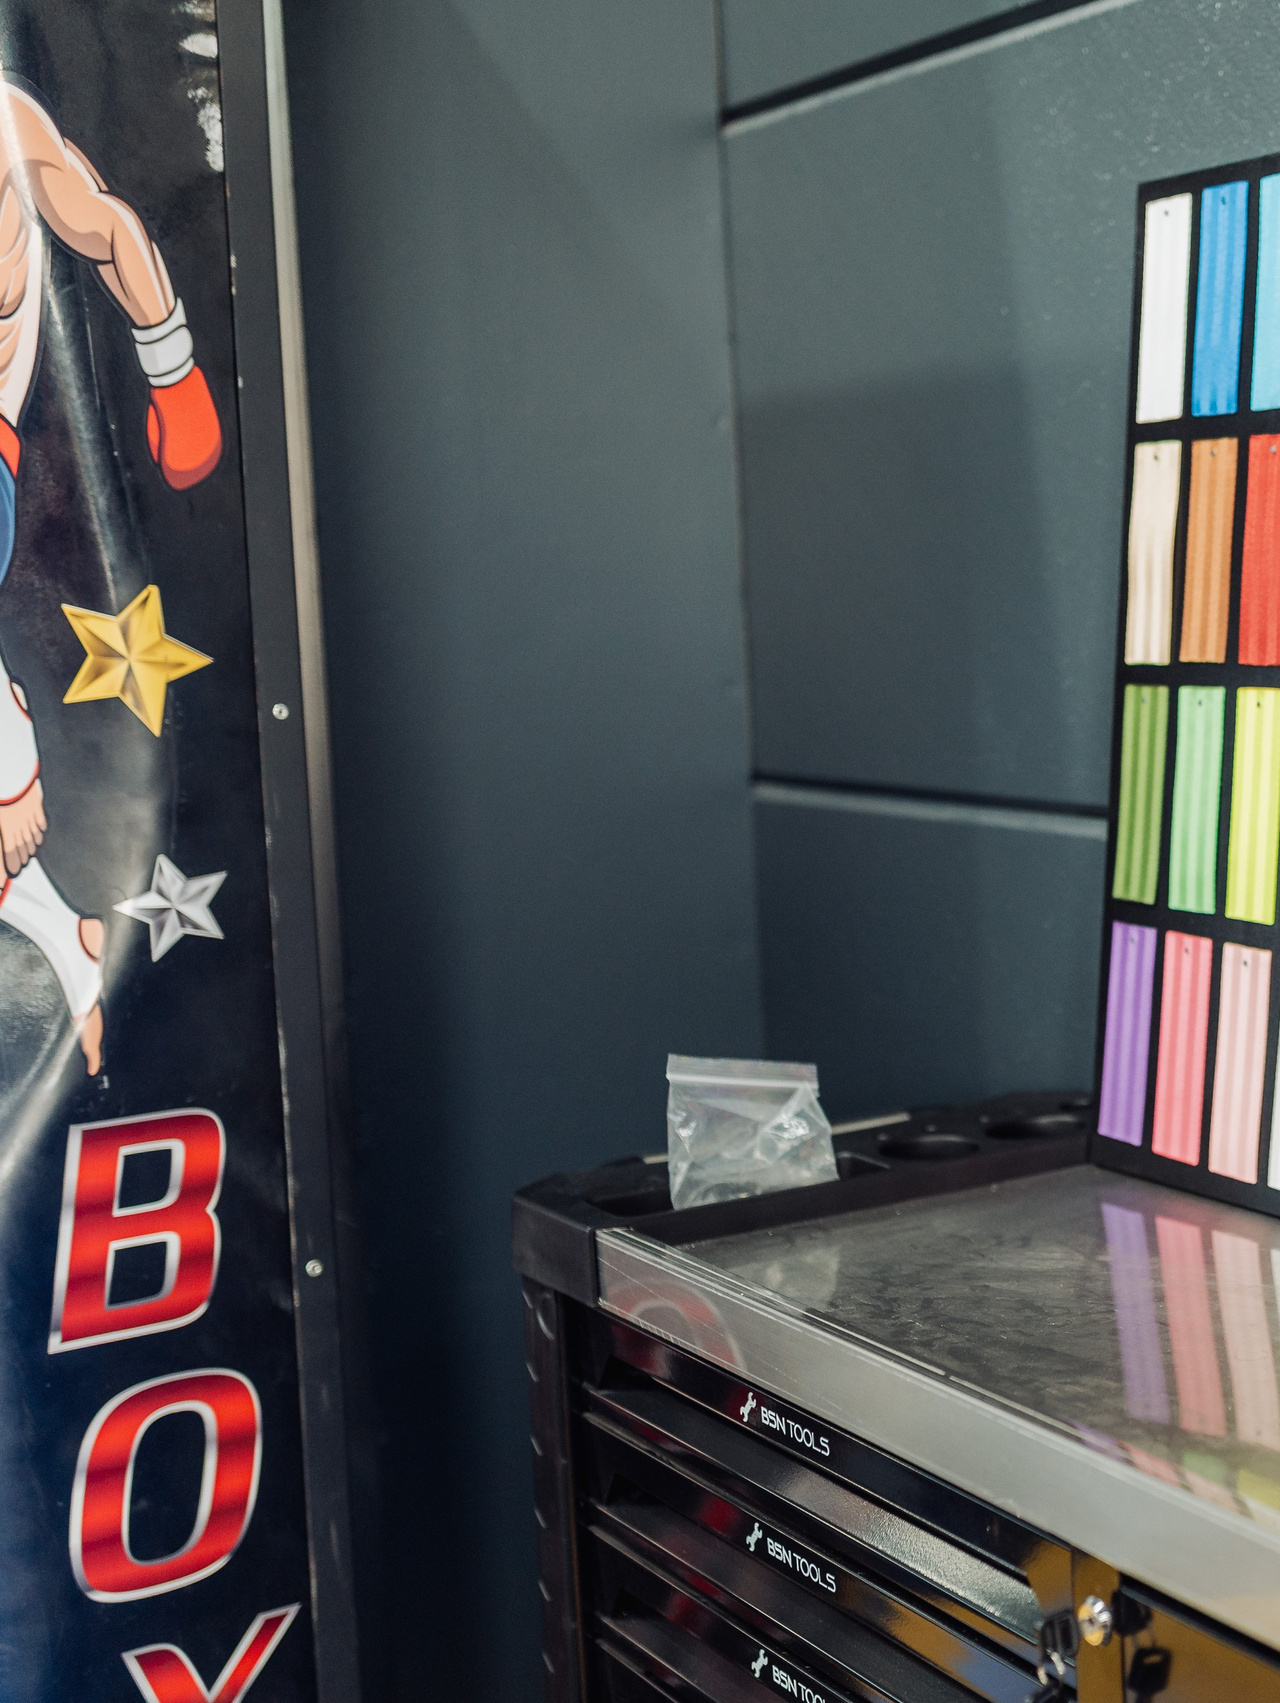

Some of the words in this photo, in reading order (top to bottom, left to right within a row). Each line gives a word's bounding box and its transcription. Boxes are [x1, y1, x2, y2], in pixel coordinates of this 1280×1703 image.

[760, 1405, 787, 1436] BSN
[786, 1419, 831, 1457] TOOLS
[766, 1537, 793, 1569] BSN
[792, 1552, 837, 1593] TOOLS
[772, 1664, 798, 1698] BSN
